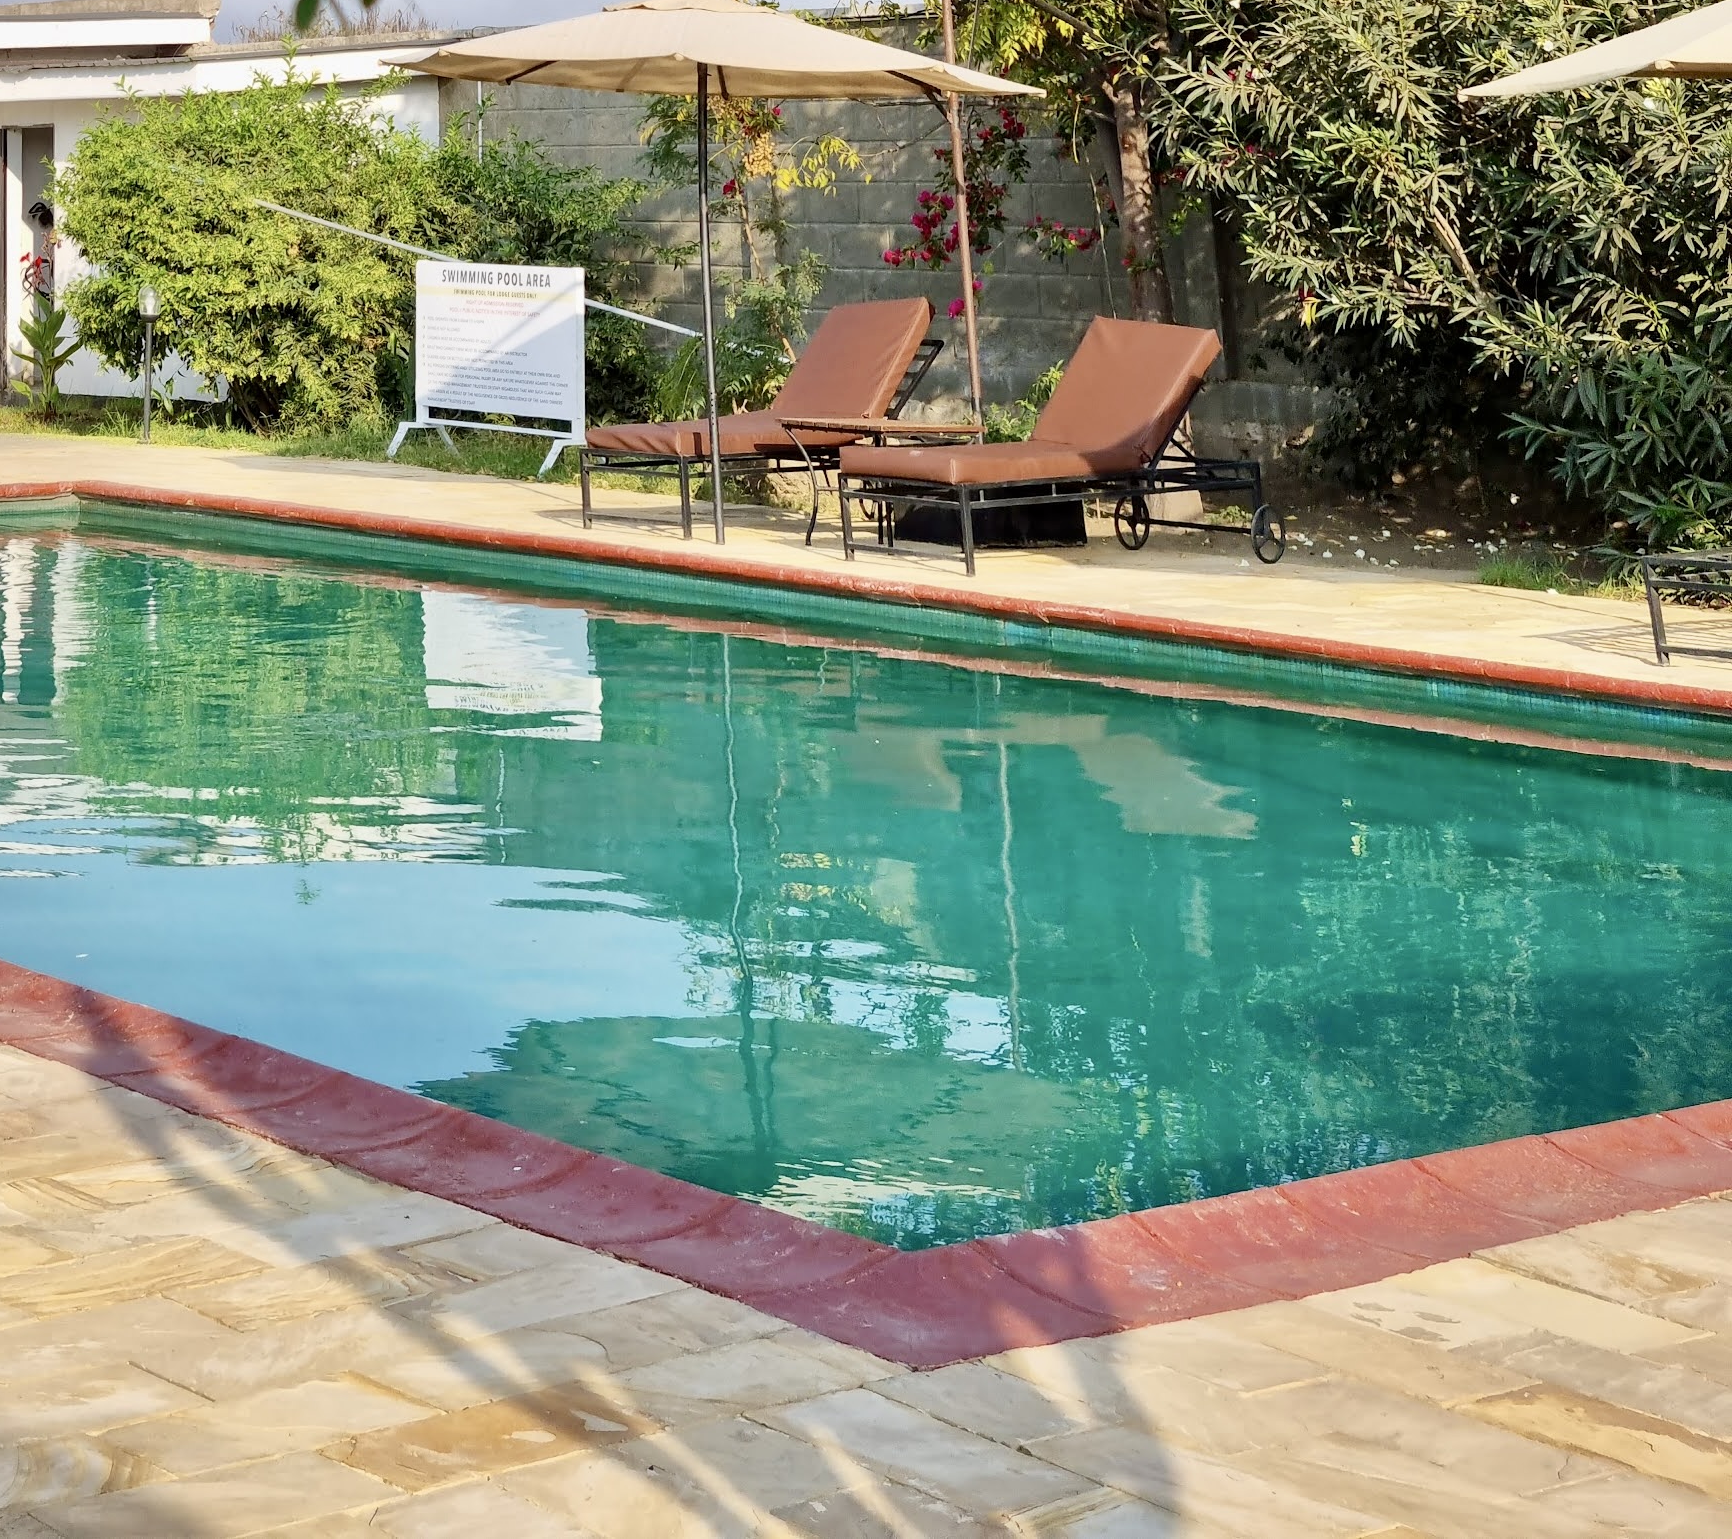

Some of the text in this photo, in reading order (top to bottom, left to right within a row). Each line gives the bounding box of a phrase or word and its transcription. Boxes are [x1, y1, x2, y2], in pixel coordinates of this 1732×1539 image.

[442, 269, 551, 288] SWIMMING POOL AREA
[453, 288, 475, 296] SWIMMING
[511, 291, 526, 299] GUESTS
